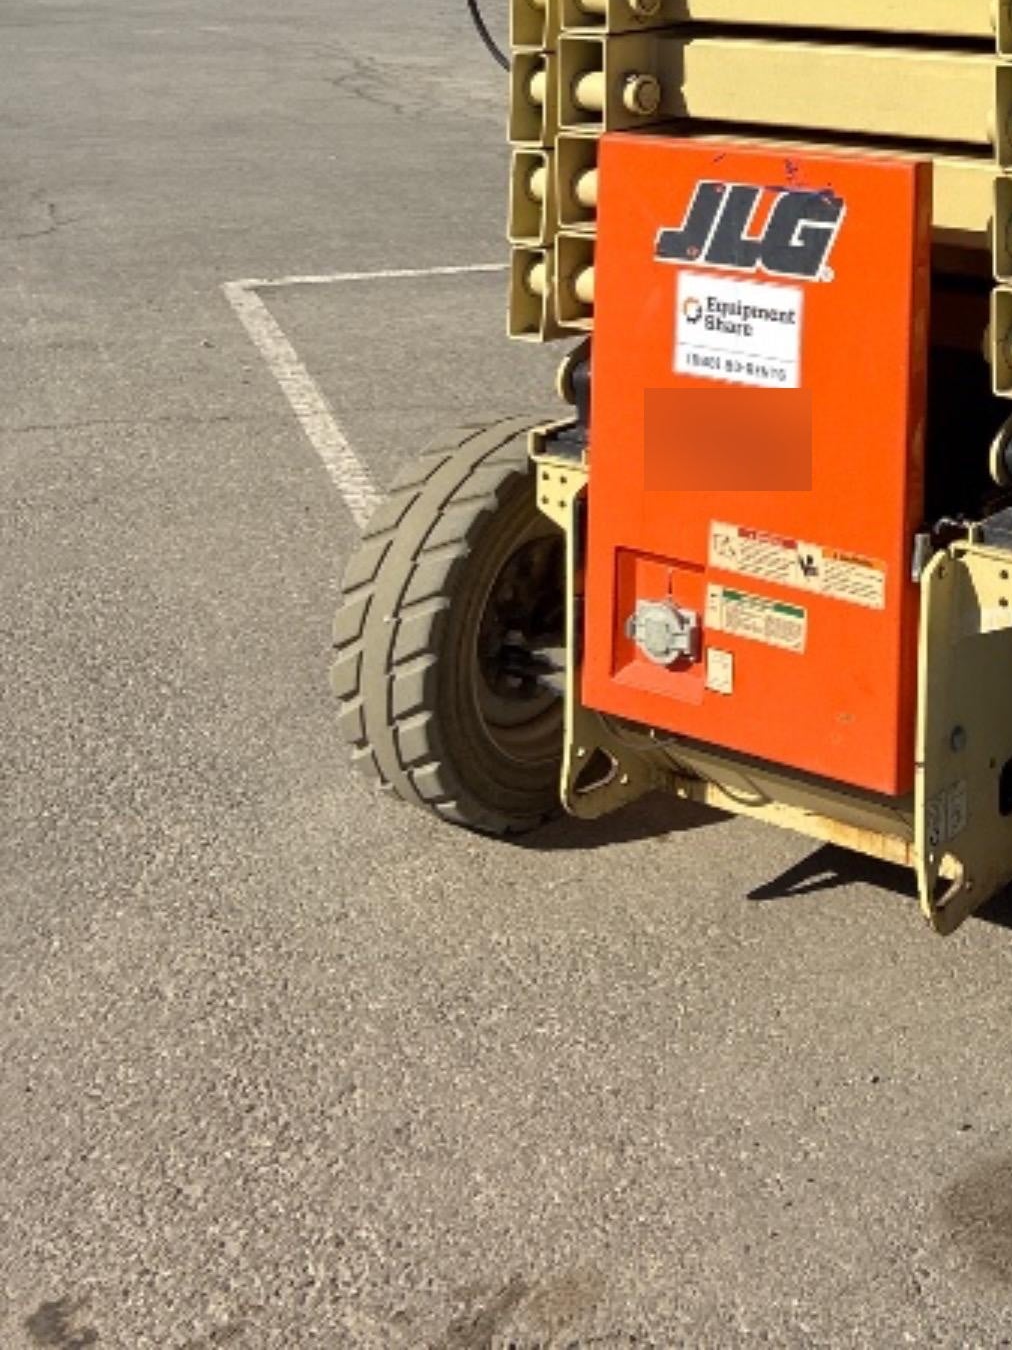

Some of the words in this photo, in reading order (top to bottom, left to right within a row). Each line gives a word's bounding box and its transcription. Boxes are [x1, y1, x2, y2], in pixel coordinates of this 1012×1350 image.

[654, 179, 847, 282] JLG
[705, 296, 796, 325] Equipment
[703, 314, 755, 337] Share
